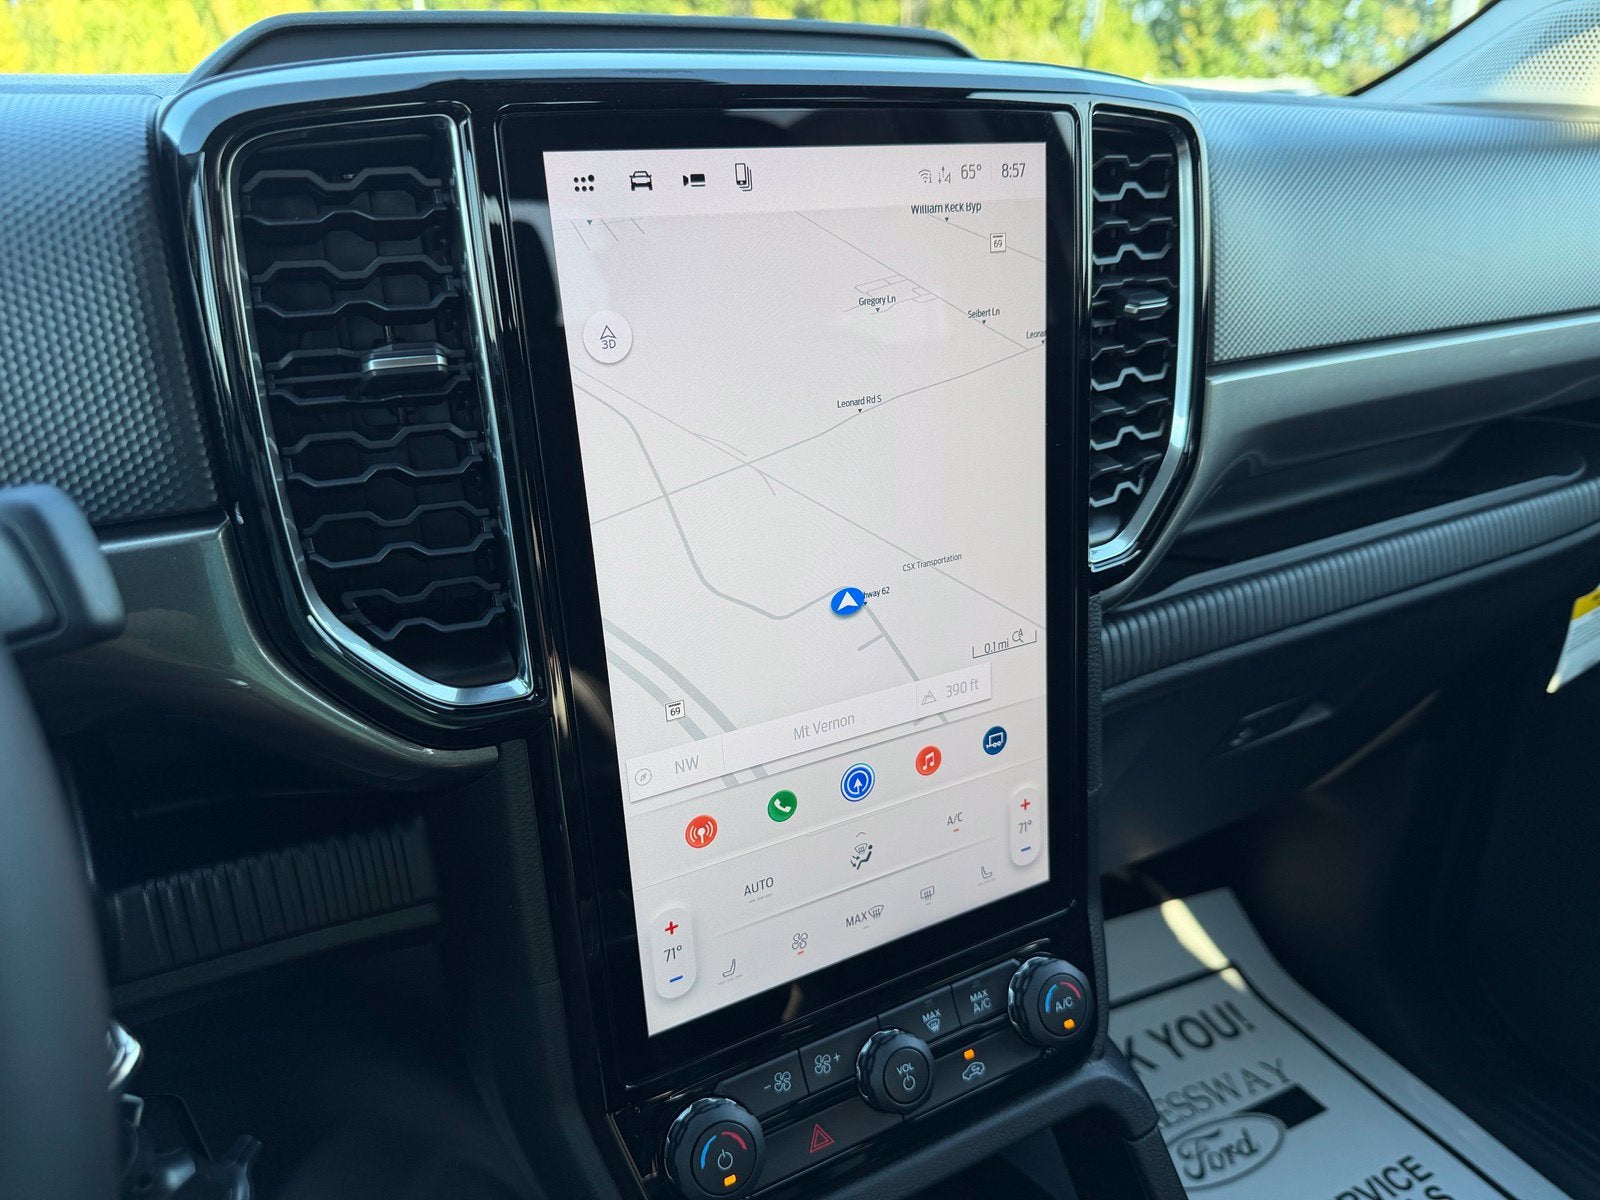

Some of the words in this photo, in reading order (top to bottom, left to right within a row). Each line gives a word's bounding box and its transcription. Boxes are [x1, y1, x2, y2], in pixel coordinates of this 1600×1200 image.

[1001, 163, 1026, 179] 8:57
[911, 203, 943, 214] William
[945, 202, 965, 213] Keck
[858, 296, 886, 307] Gregory
[887, 294, 896, 303] Ln
[967, 309, 991, 318] Seibert
[992, 307, 1000, 316] Ln
[601, 339, 616, 350] 3D
[837, 397, 865, 409] Leonard
[866, 395, 876, 405] Rd
[877, 394, 882, 403] S
[903, 561, 916, 572] CSX
[917, 553, 962, 569] Transportation
[864, 588, 881, 599] hway
[881, 586, 890, 595] 62
[946, 681, 968, 698] 390
[968, 678, 979, 691] ft
[670, 706, 681, 716] 69
[793, 724, 811, 740] Mt
[812, 714, 855, 734] Vernon
[674, 755, 699, 774] NW
[947, 812, 963, 826] A/C
[743, 877, 774, 896] AUTO
[845, 911, 868, 928] MAX
[969, 988, 989, 1003] MAX
[972, 997, 992, 1014] A/C
[1054, 996, 1073, 1013] A/C
[922, 1008, 942, 1023] MAX
[1146, 1000, 1255, 1061] YOU!
[896, 1062, 915, 1075] VOL
[1156, 1057, 1292, 1128] ESSWAY
[1176, 1126, 1262, 1181] Ford
